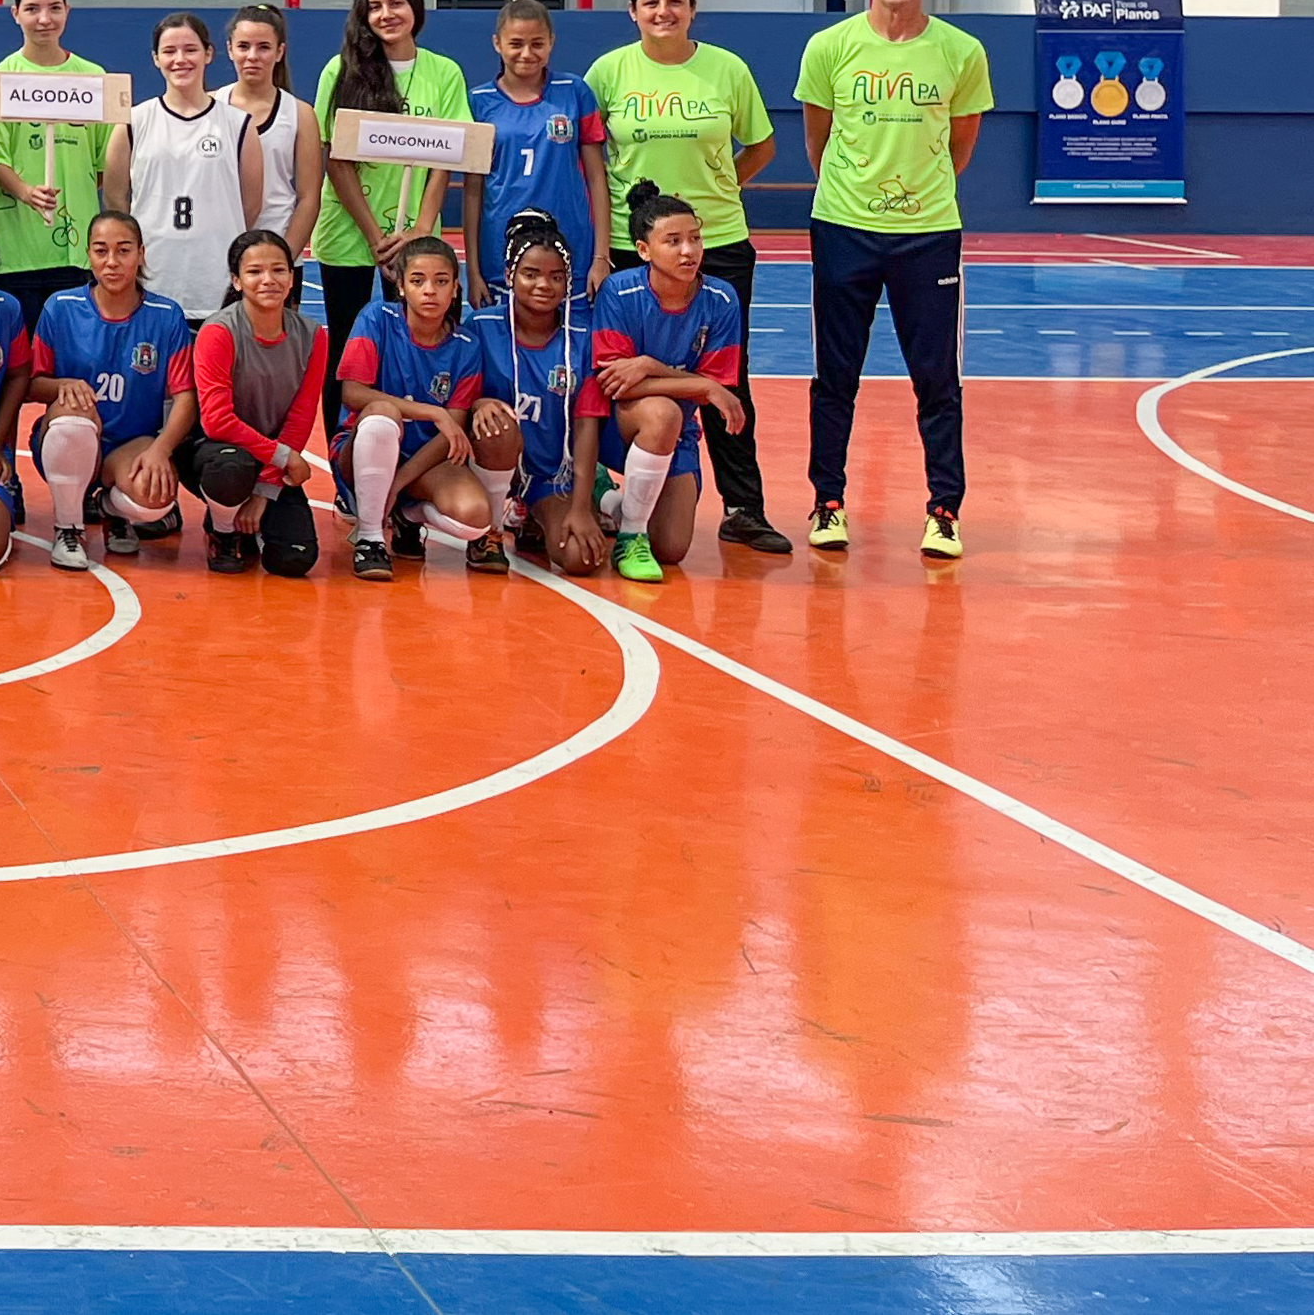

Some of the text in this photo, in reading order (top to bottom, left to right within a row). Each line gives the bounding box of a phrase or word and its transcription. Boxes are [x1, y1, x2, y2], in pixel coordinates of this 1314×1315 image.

[1082, 2, 1112, 18] PAF
[1116, 8, 1160, 20] Planos
[9, 88, 93, 104] ALGODÃO
[369, 133, 452, 150] CONGONHAL
[520, 148, 534, 176] 7
[173, 196, 193, 230] 8
[96, 373, 125, 403] 20
[518, 393, 542, 423] 27
